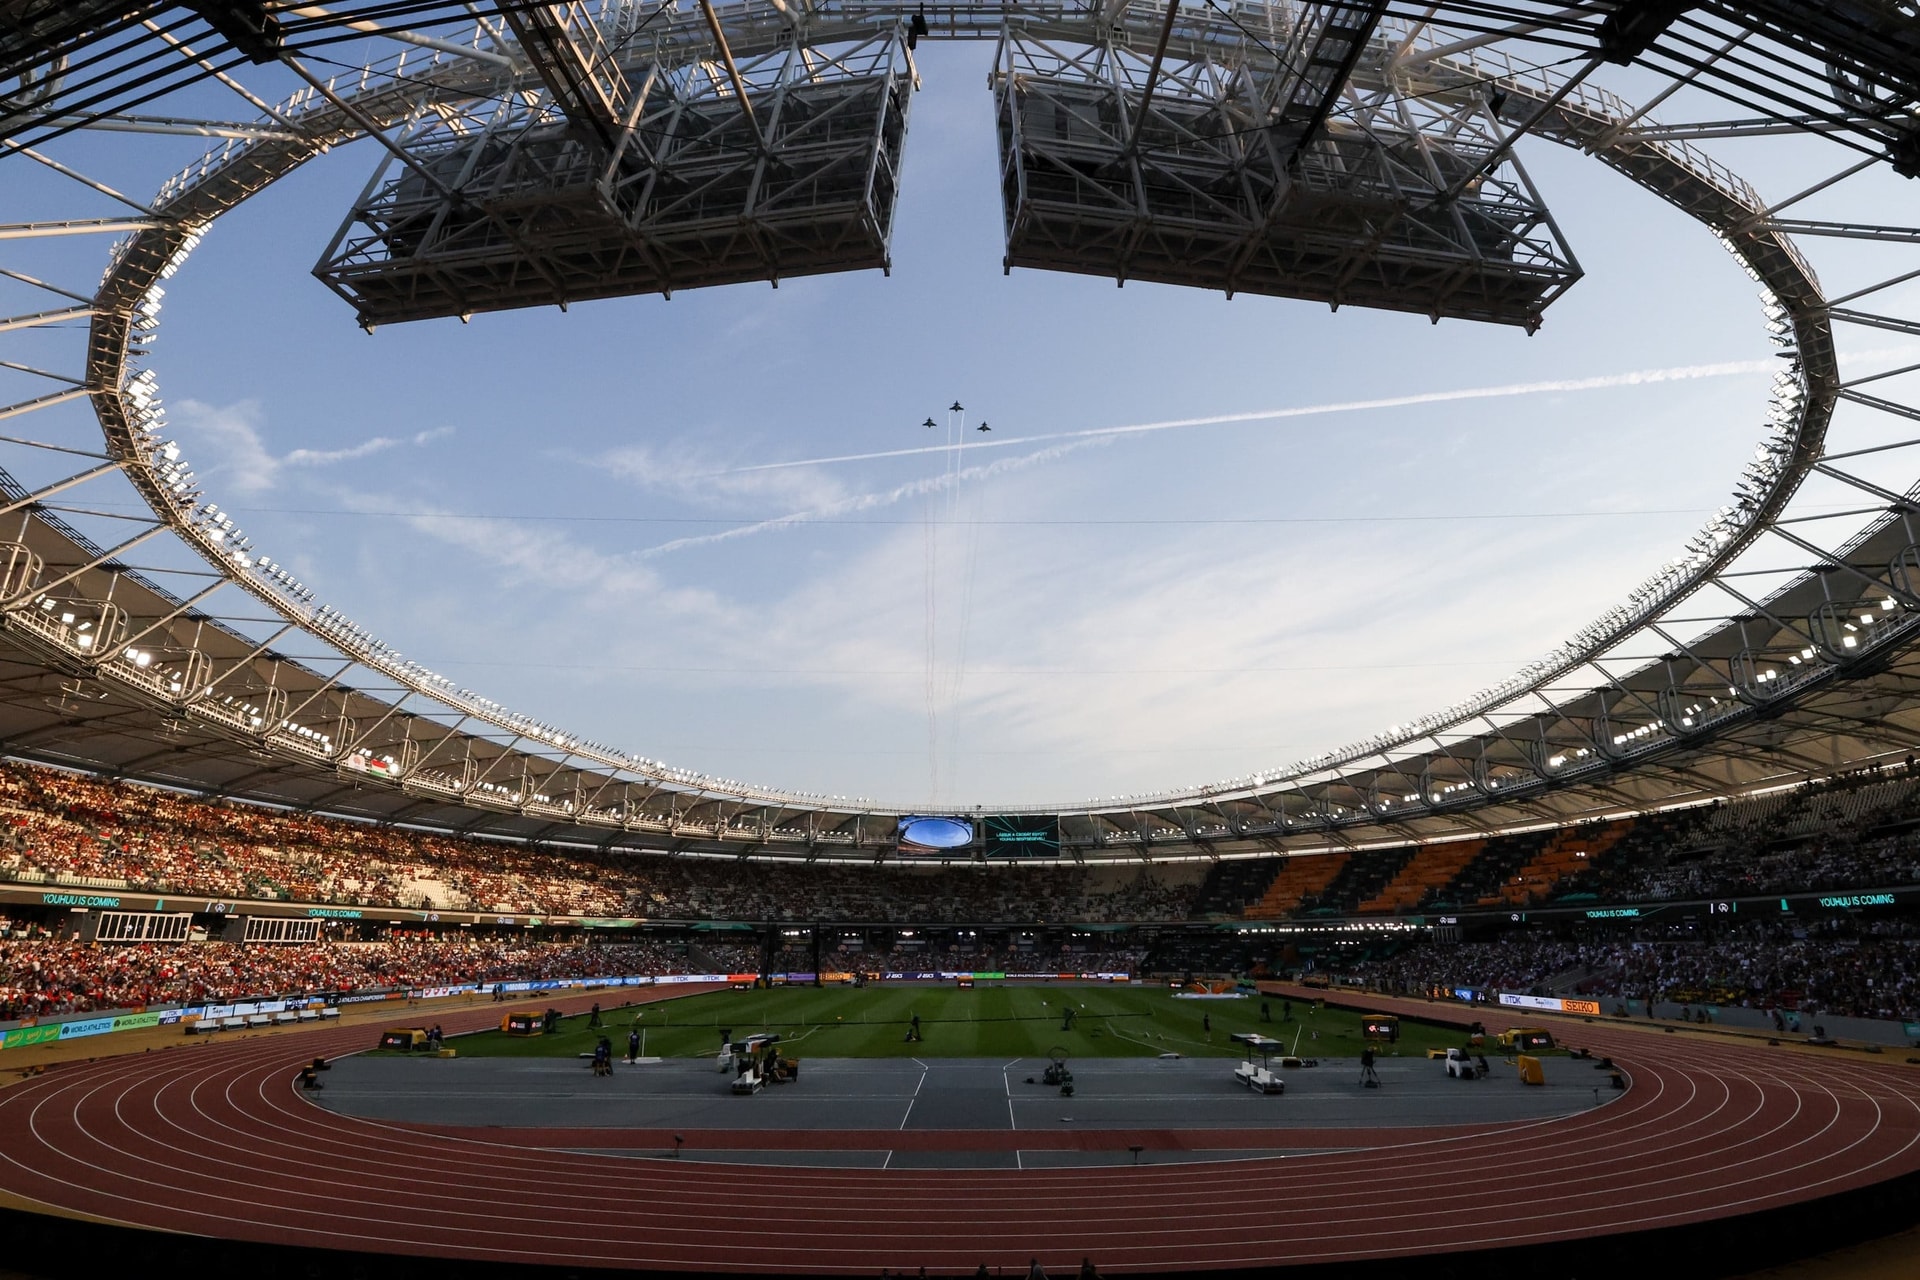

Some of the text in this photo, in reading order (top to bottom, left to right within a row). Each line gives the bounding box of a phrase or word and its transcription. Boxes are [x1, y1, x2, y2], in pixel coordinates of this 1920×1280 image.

[43, 893, 120, 907] YOUHUU IS COMING
[1819, 894, 1895, 907] YOUHUU IS COMING
[309, 909, 332, 917] YOUHUU
[339, 910, 362, 918] COMING
[1586, 910, 1609, 918] YOUHUU
[1615, 908, 1639, 917] COMING
[1508, 996, 1521, 1004] TDK
[1566, 1000, 1594, 1013] SEIKO
[121, 1018, 137, 1026] WORLD
[137, 1016, 158, 1024] ATHLETICS
[70, 1022, 111, 1033] WORLD ATHLETICS
